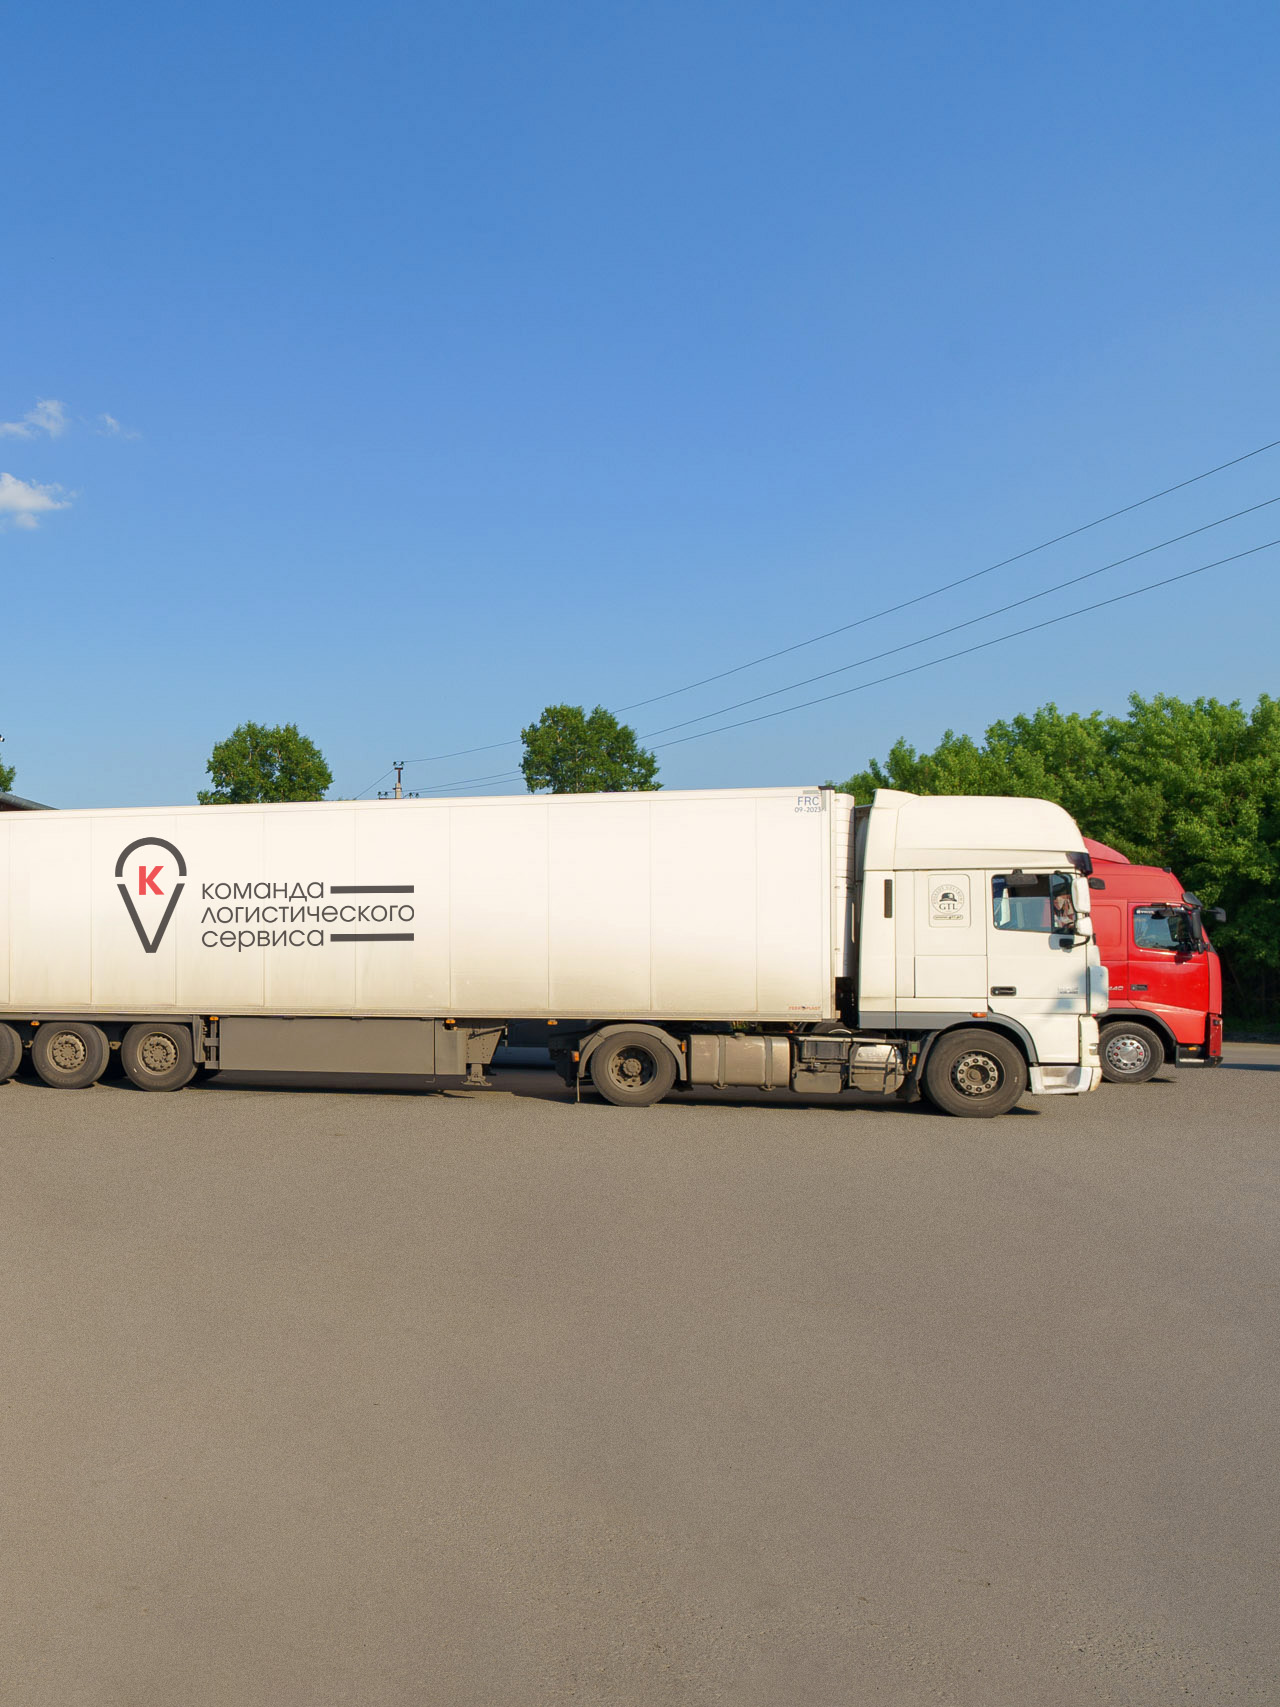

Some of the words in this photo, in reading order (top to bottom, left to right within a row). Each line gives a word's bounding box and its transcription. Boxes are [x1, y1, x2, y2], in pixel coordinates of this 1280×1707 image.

[797, 796, 820, 806] FRC
[201, 881, 324, 902] команда
[201, 904, 415, 924] логистического
[938, 902, 958, 911] GTL
[201, 929, 324, 952] сервиса
